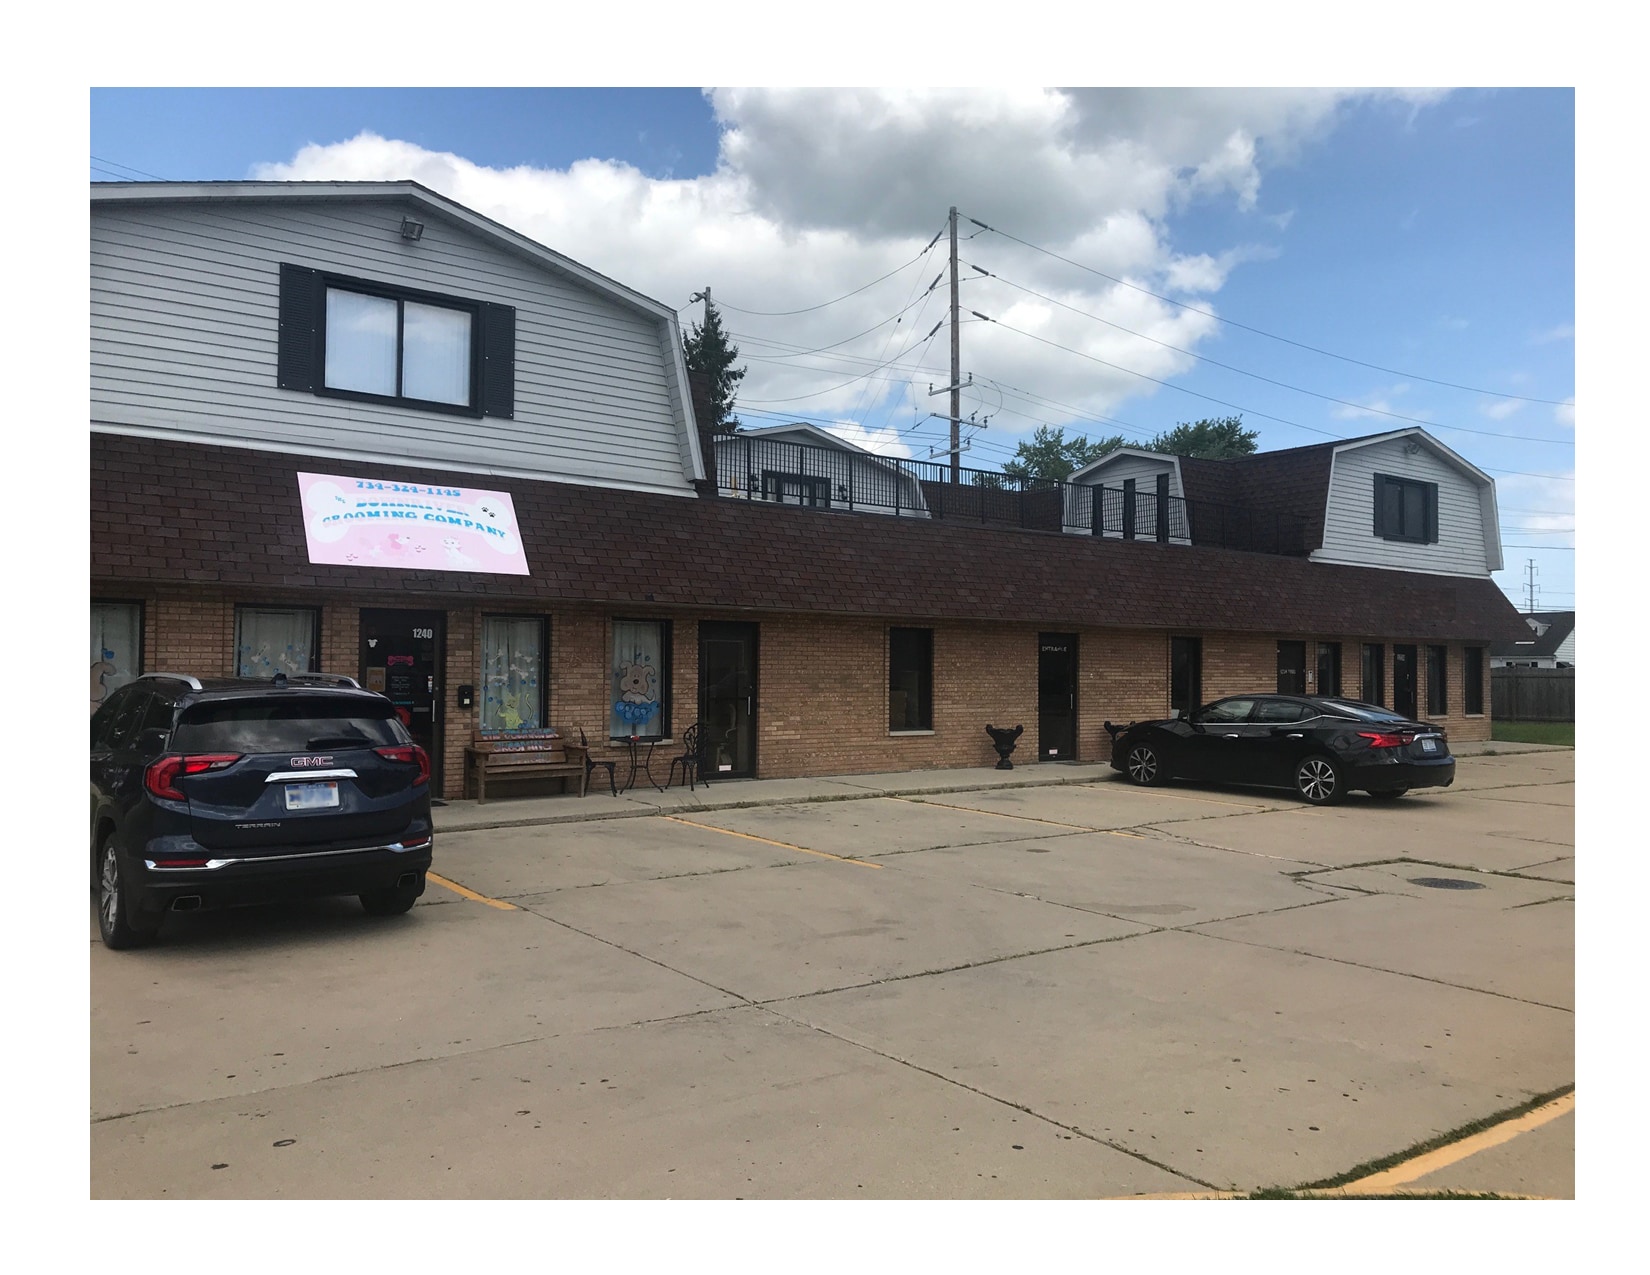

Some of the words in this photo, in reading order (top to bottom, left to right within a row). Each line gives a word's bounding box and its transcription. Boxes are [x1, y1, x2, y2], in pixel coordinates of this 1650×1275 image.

[356, 481, 461, 497] 734-324-1145
[423, 513, 506, 538] COMPANY
[412, 628, 433, 639] 1240
[290, 756, 334, 768] GMC
